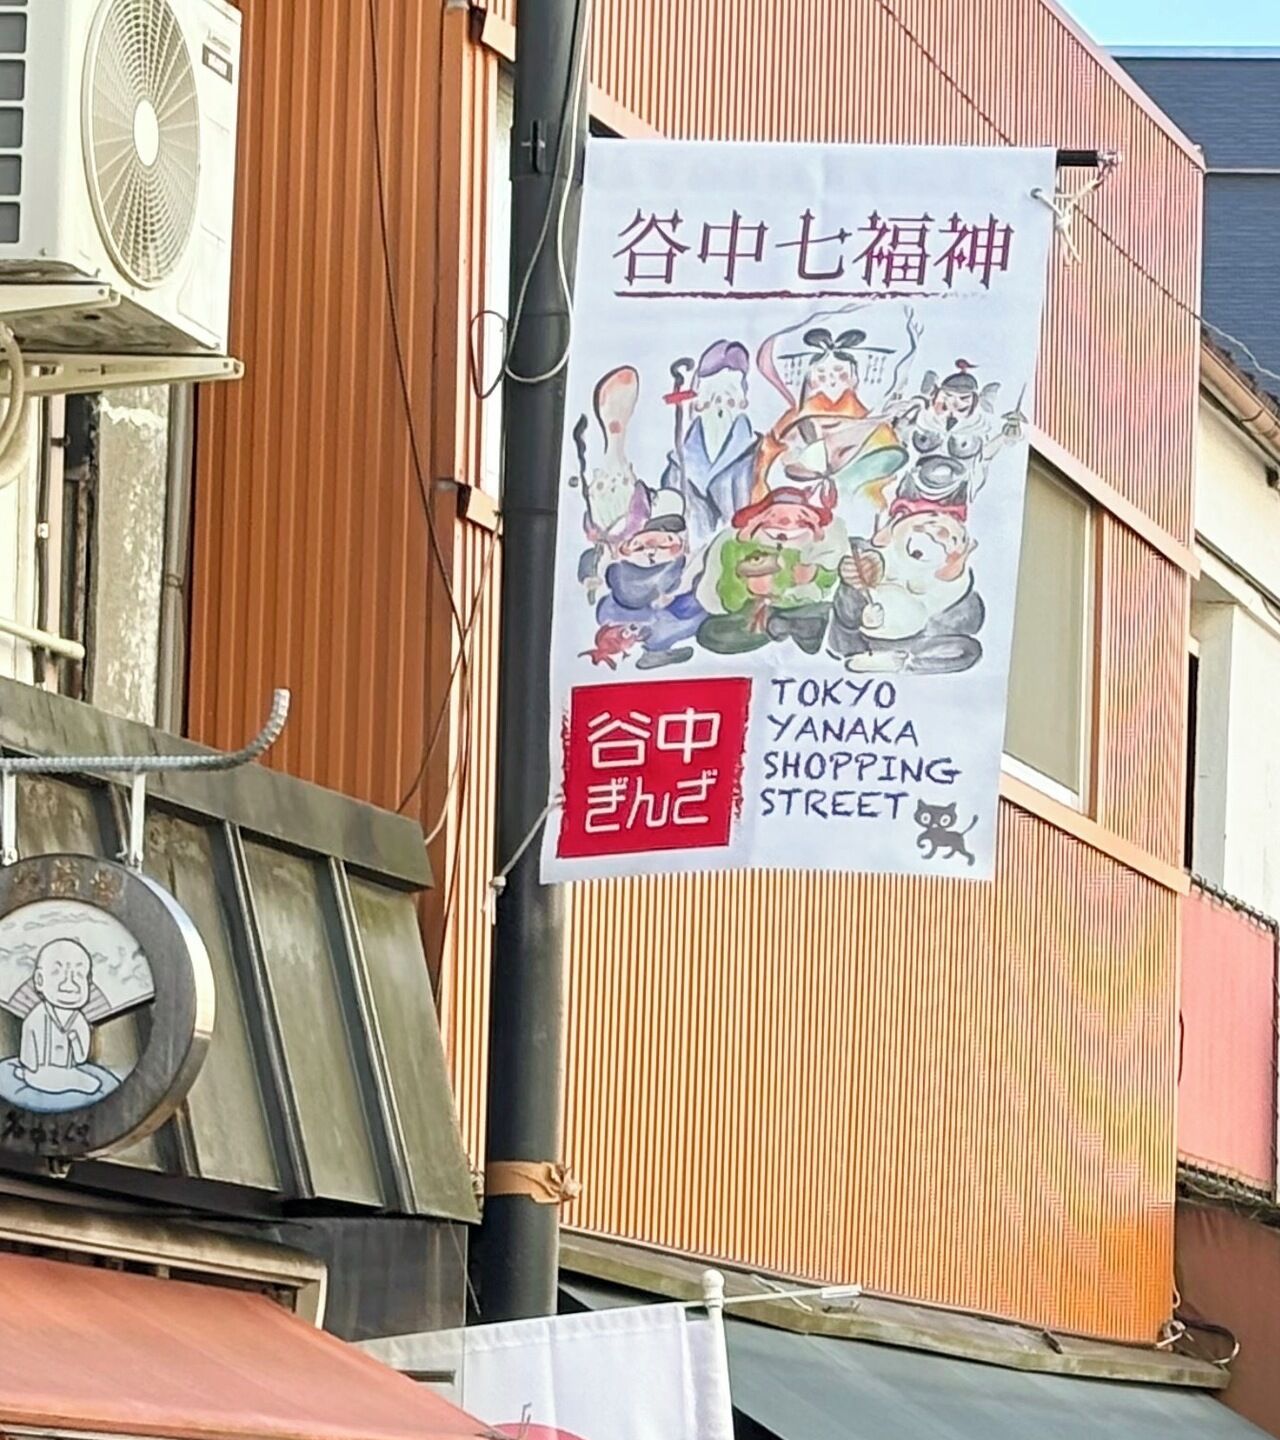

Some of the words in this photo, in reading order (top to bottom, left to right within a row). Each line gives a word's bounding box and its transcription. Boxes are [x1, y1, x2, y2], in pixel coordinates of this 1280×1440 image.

[613, 207, 1016, 289] 谷中七福神
[773, 678, 897, 709] TOKYO
[586, 706, 722, 768] 谷中
[766, 716, 919, 747] YANAKA
[762, 751, 962, 785] SHOPPING
[585, 769, 719, 835] ぎんざ
[760, 789, 909, 820] STREET
